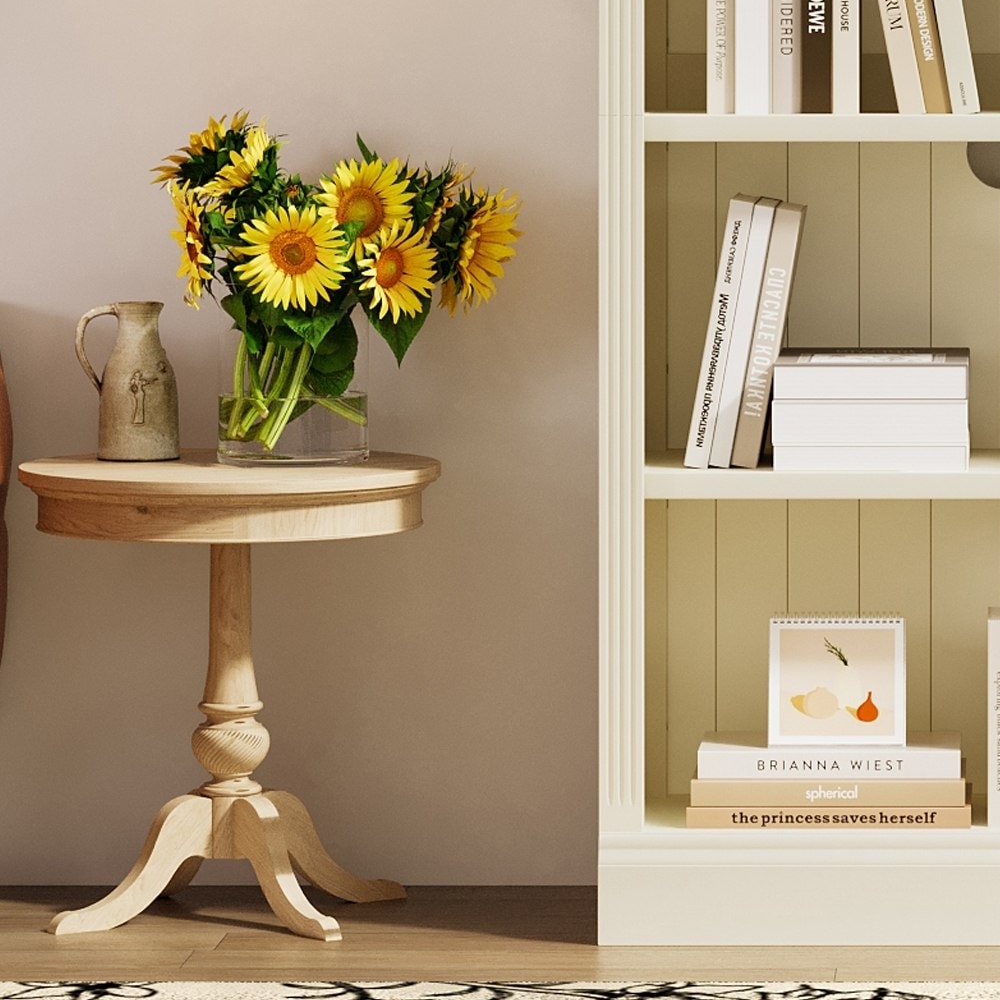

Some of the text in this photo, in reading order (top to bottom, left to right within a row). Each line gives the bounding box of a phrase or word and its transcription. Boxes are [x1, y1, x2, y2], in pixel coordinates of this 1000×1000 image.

[716, 8, 726, 37] POWER
[716, 39, 726, 51] OF
[917, 29, 934, 61] DESIGN
[757, 760, 904, 771] BRIANNA WIEST
[806, 785, 858, 802] spherical
[732, 811, 937, 827] the princess saves herself
